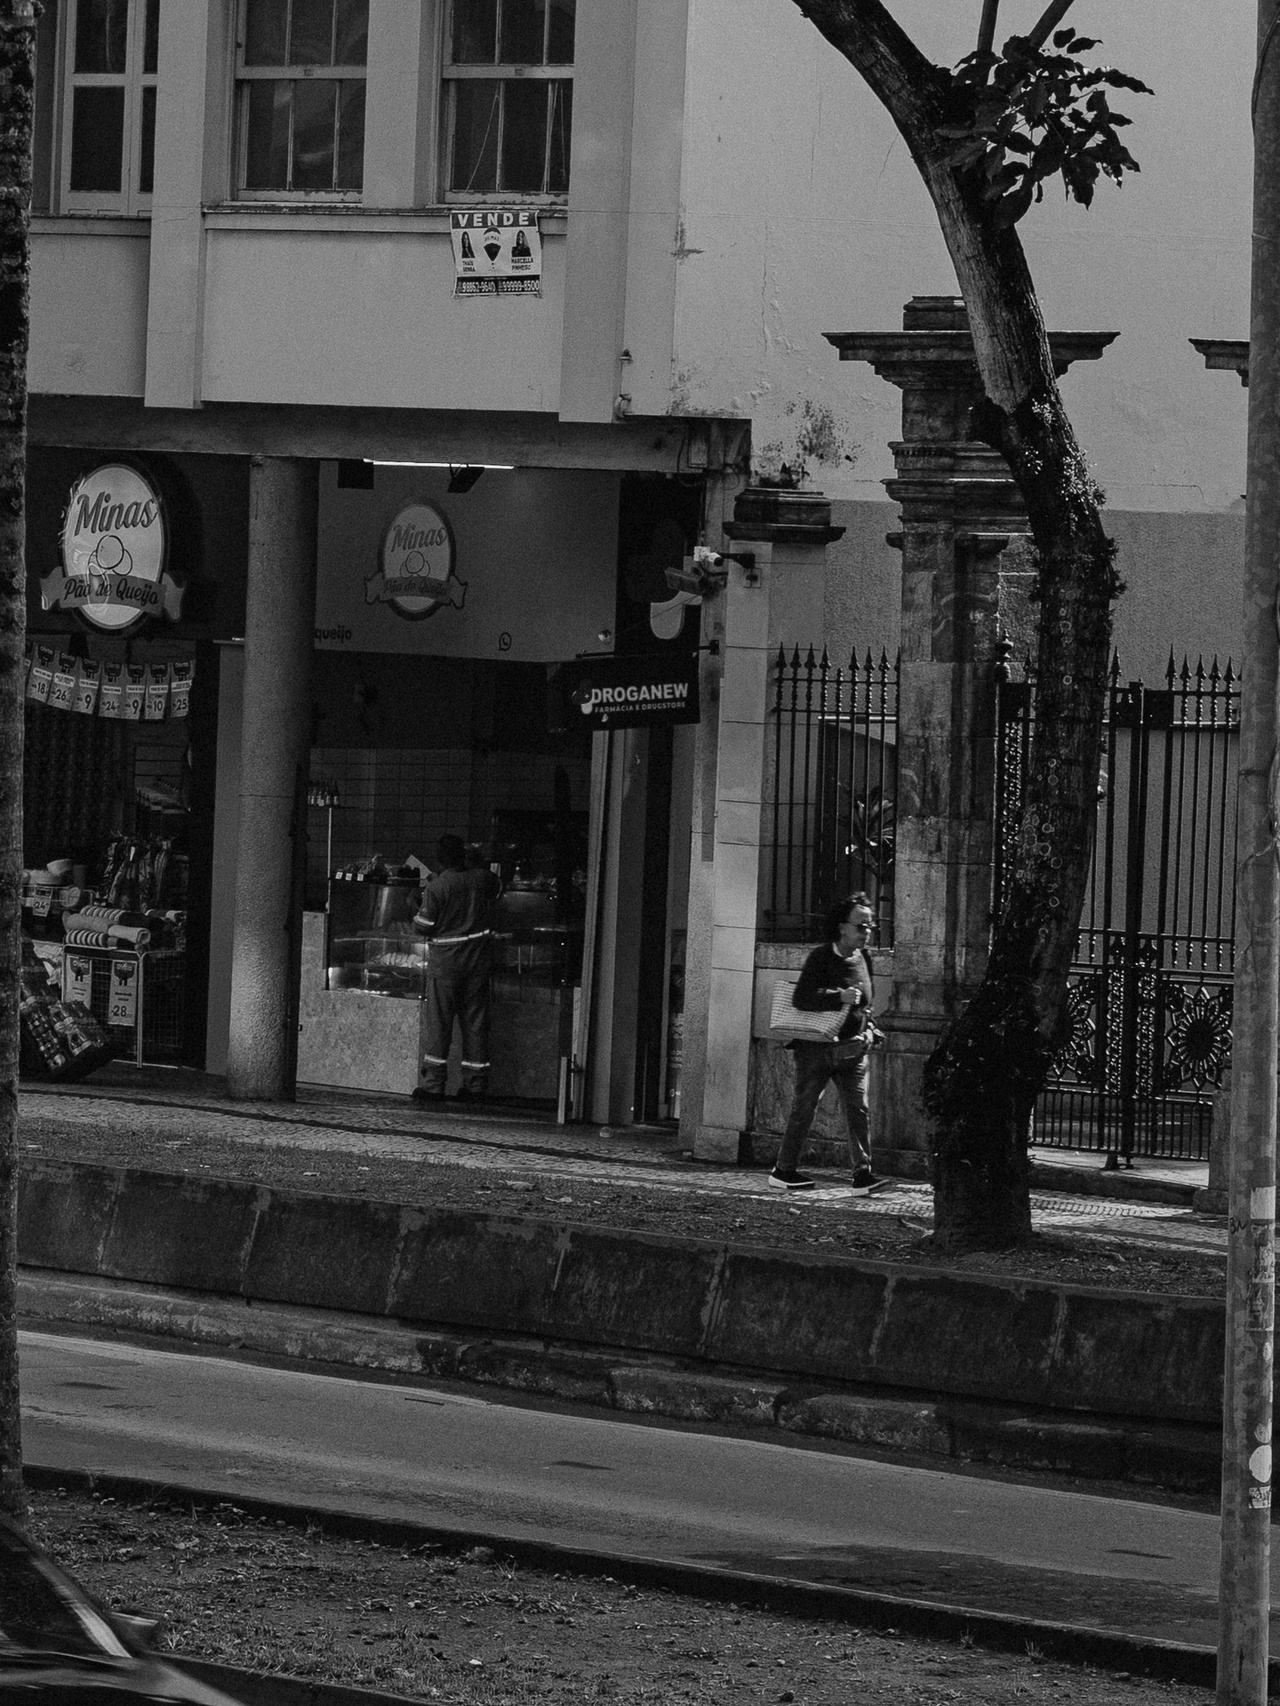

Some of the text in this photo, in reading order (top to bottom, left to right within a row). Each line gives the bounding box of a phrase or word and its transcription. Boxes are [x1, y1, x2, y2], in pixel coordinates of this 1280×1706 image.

[457, 212, 530, 227] VENDE
[74, 491, 158, 536] Minas
[391, 523, 448, 553] Minas
[64, 578, 92, 600] Pão
[116, 577, 158, 606] Queijo
[591, 682, 689, 704] DROGANEW
[113, 1004, 127, 1017] 28
